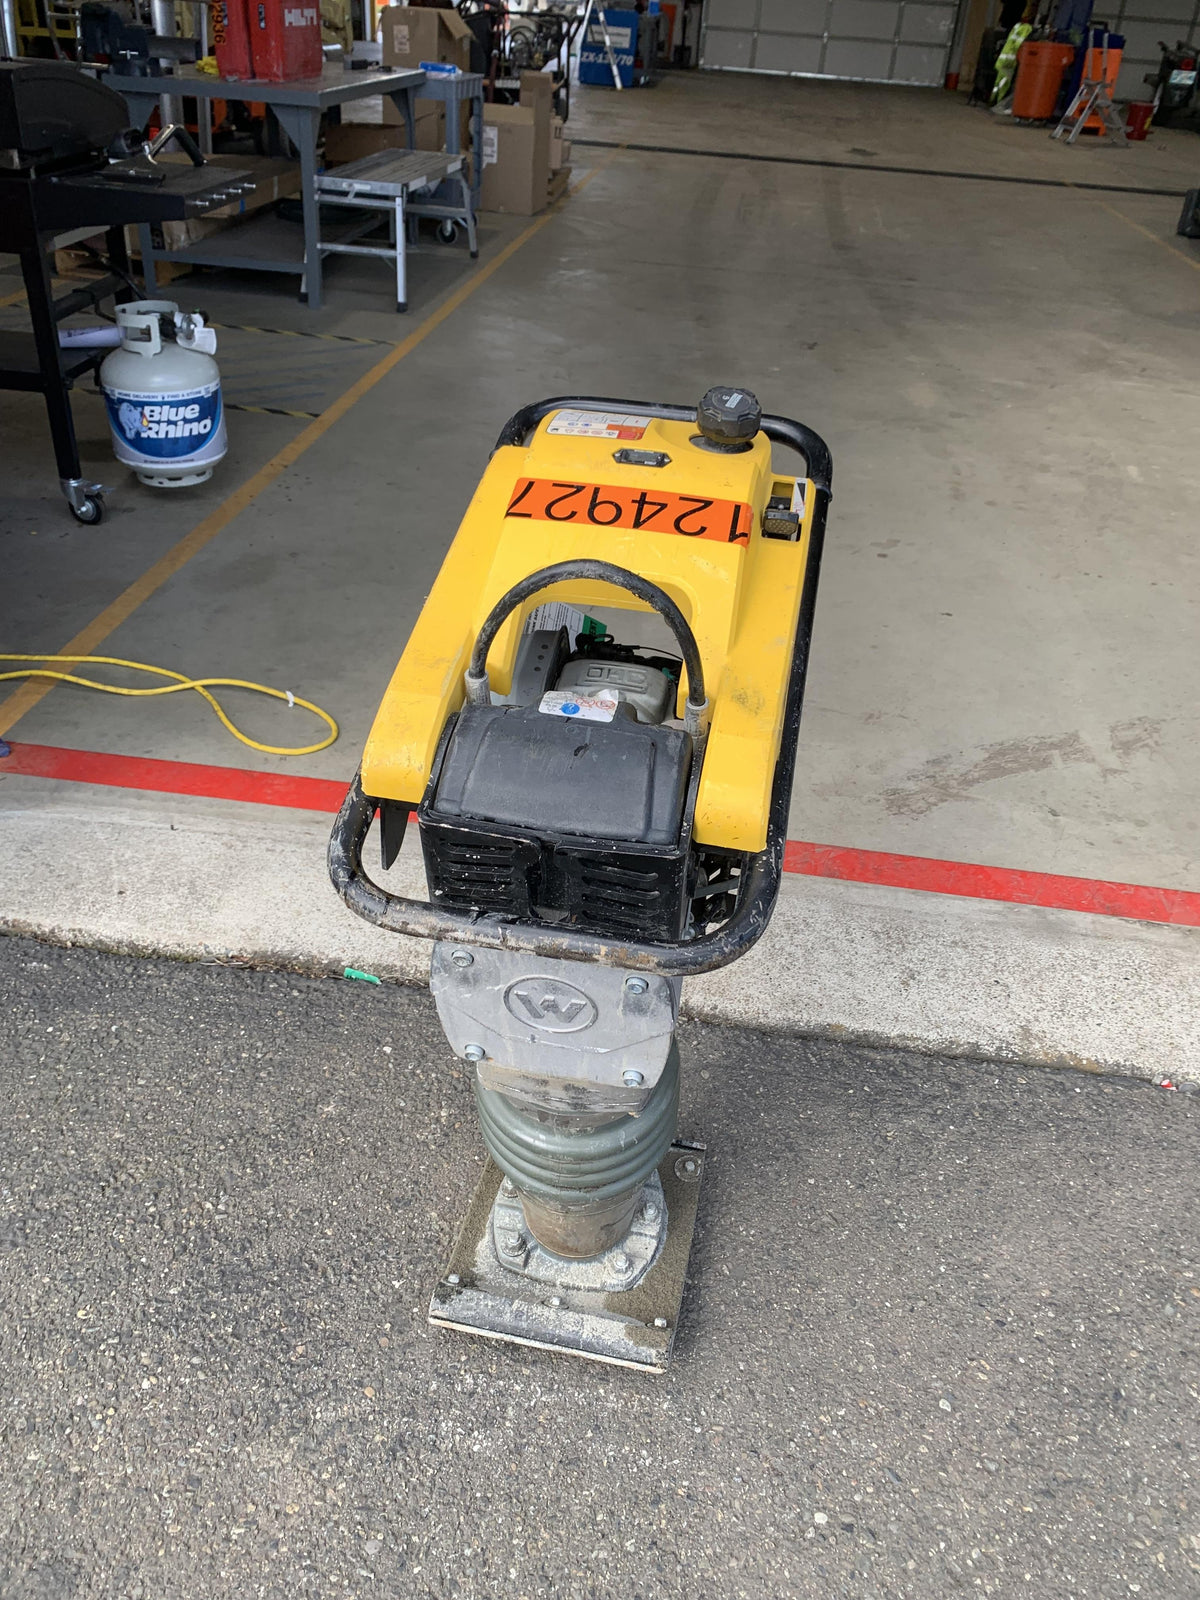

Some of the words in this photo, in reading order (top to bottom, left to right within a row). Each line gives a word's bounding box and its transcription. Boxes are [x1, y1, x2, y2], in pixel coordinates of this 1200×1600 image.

[284, 8, 317, 26] HILTI
[143, 403, 199, 421] Blue
[140, 417, 212, 439] Rhino
[504, 480, 750, 543] 124927
